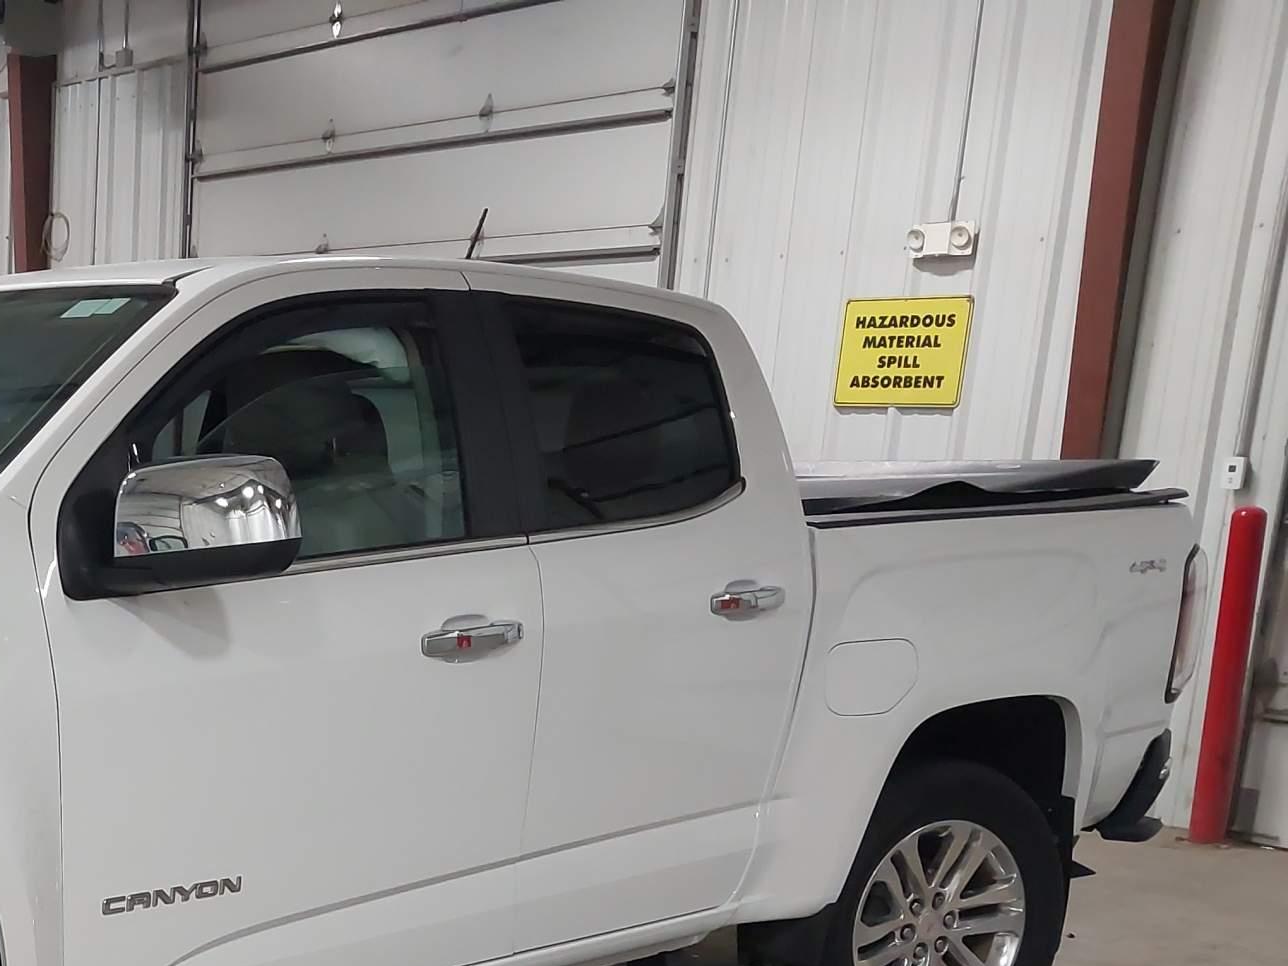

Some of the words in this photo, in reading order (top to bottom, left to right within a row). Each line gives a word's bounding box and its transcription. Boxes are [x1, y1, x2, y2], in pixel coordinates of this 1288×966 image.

[855, 314, 957, 329] HAZARDOUS
[862, 335, 942, 349] MATERIAL
[877, 355, 921, 369] SPILL
[849, 375, 945, 389] ABSORBENT
[101, 875, 242, 916] CANYON
